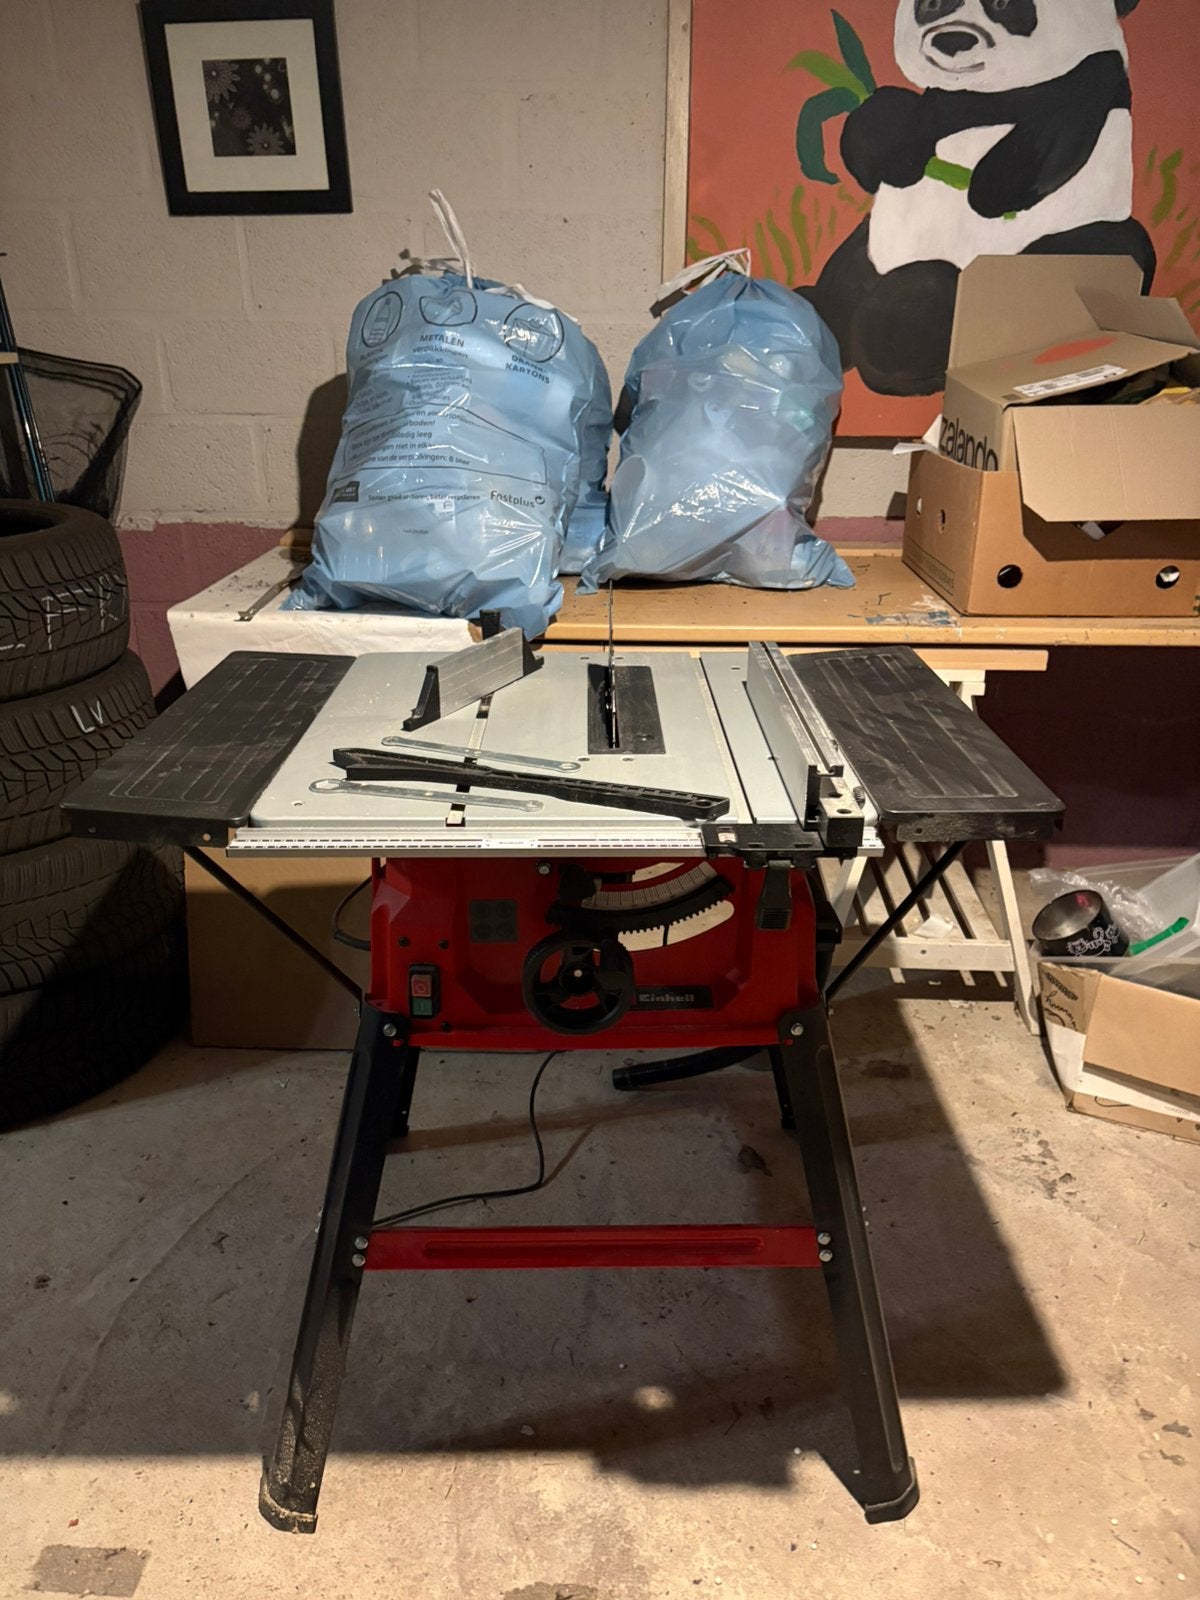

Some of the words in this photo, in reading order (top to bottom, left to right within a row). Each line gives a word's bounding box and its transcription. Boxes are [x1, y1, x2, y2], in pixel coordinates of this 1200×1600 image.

[419, 333, 465, 348] METALEN
[505, 361, 550, 385] KARTONS
[938, 415, 999, 471] zalando
[490, 490, 536, 508] Fostplus
[639, 992, 696, 1003] Einhell
